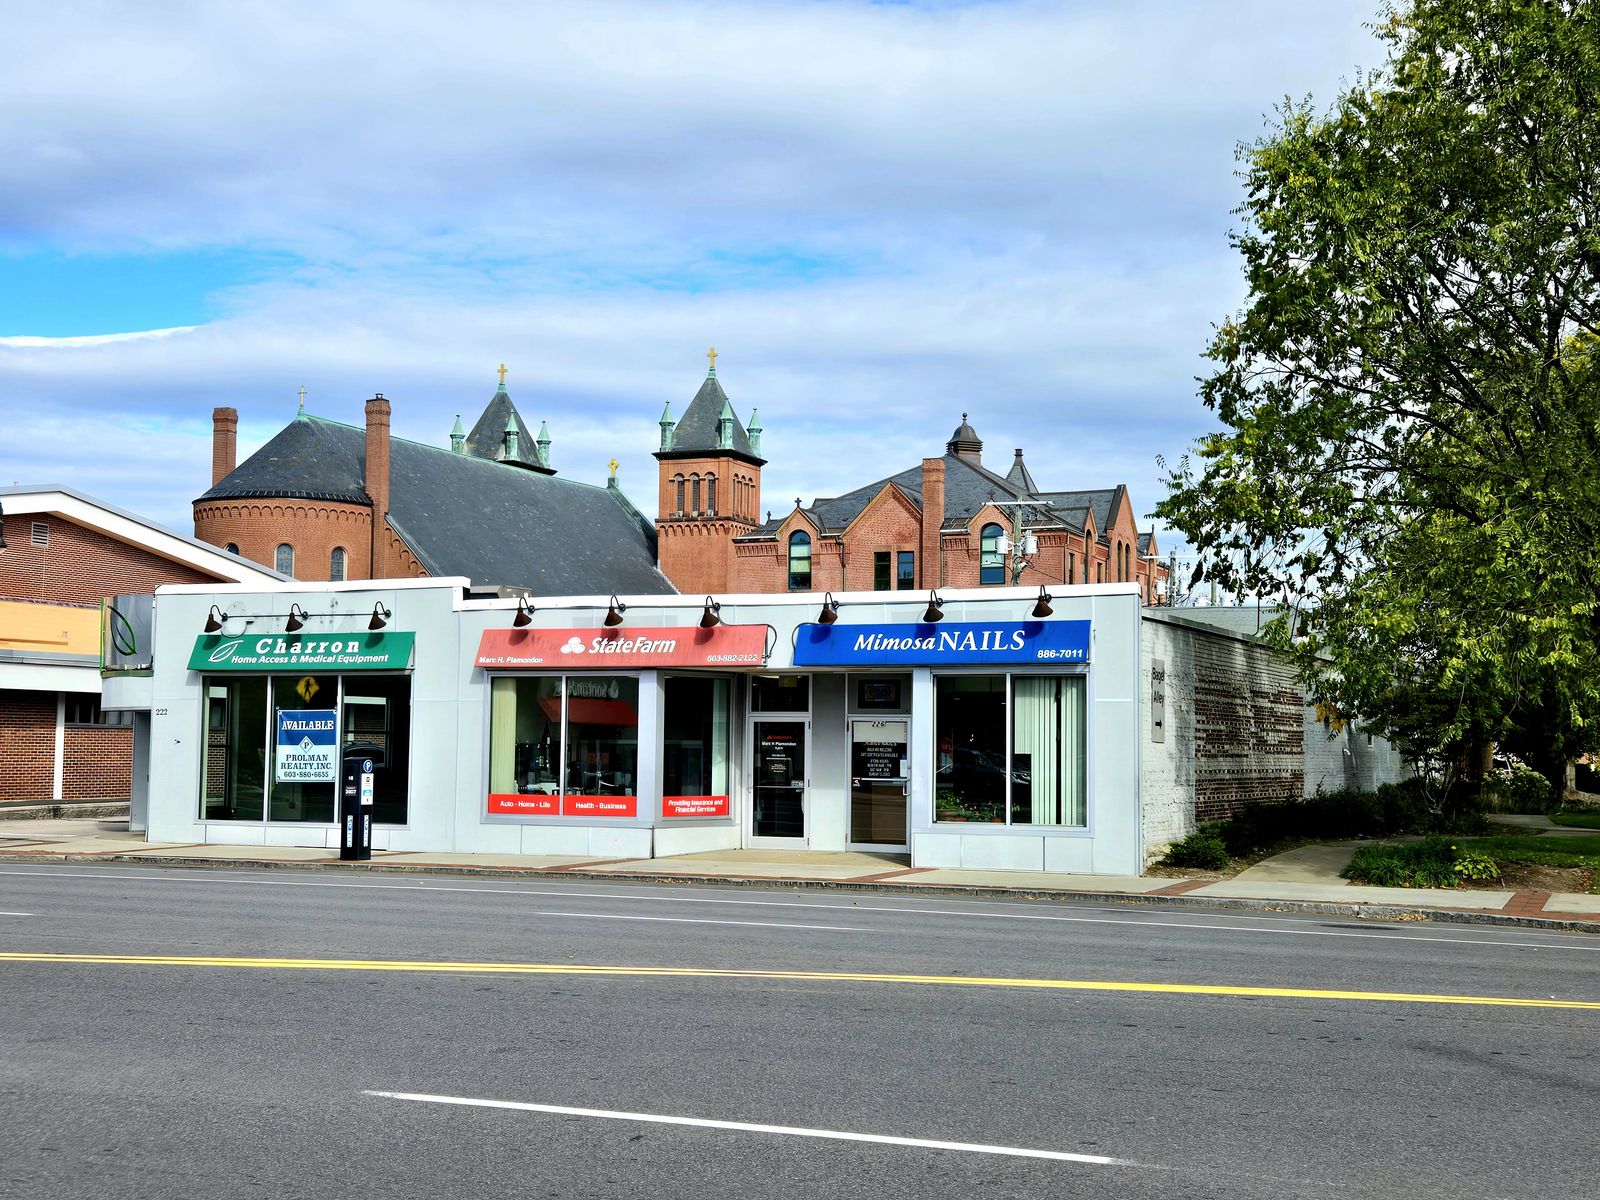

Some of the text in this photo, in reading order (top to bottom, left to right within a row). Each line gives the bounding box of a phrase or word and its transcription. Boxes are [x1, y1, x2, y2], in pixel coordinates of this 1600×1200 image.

[255, 638, 360, 654] Charron
[707, 653, 759, 662] 603-882-2122
[1037, 649, 1083, 659] 886-7011
[231, 654, 389, 664] Home Access & Medical Equipment
[506, 656, 544, 664] Plamondon
[155, 708, 168, 716] 222
[281, 720, 334, 731] AVAILABLE
[304, 741, 310, 749] P
[285, 754, 329, 762] PROLMAN
